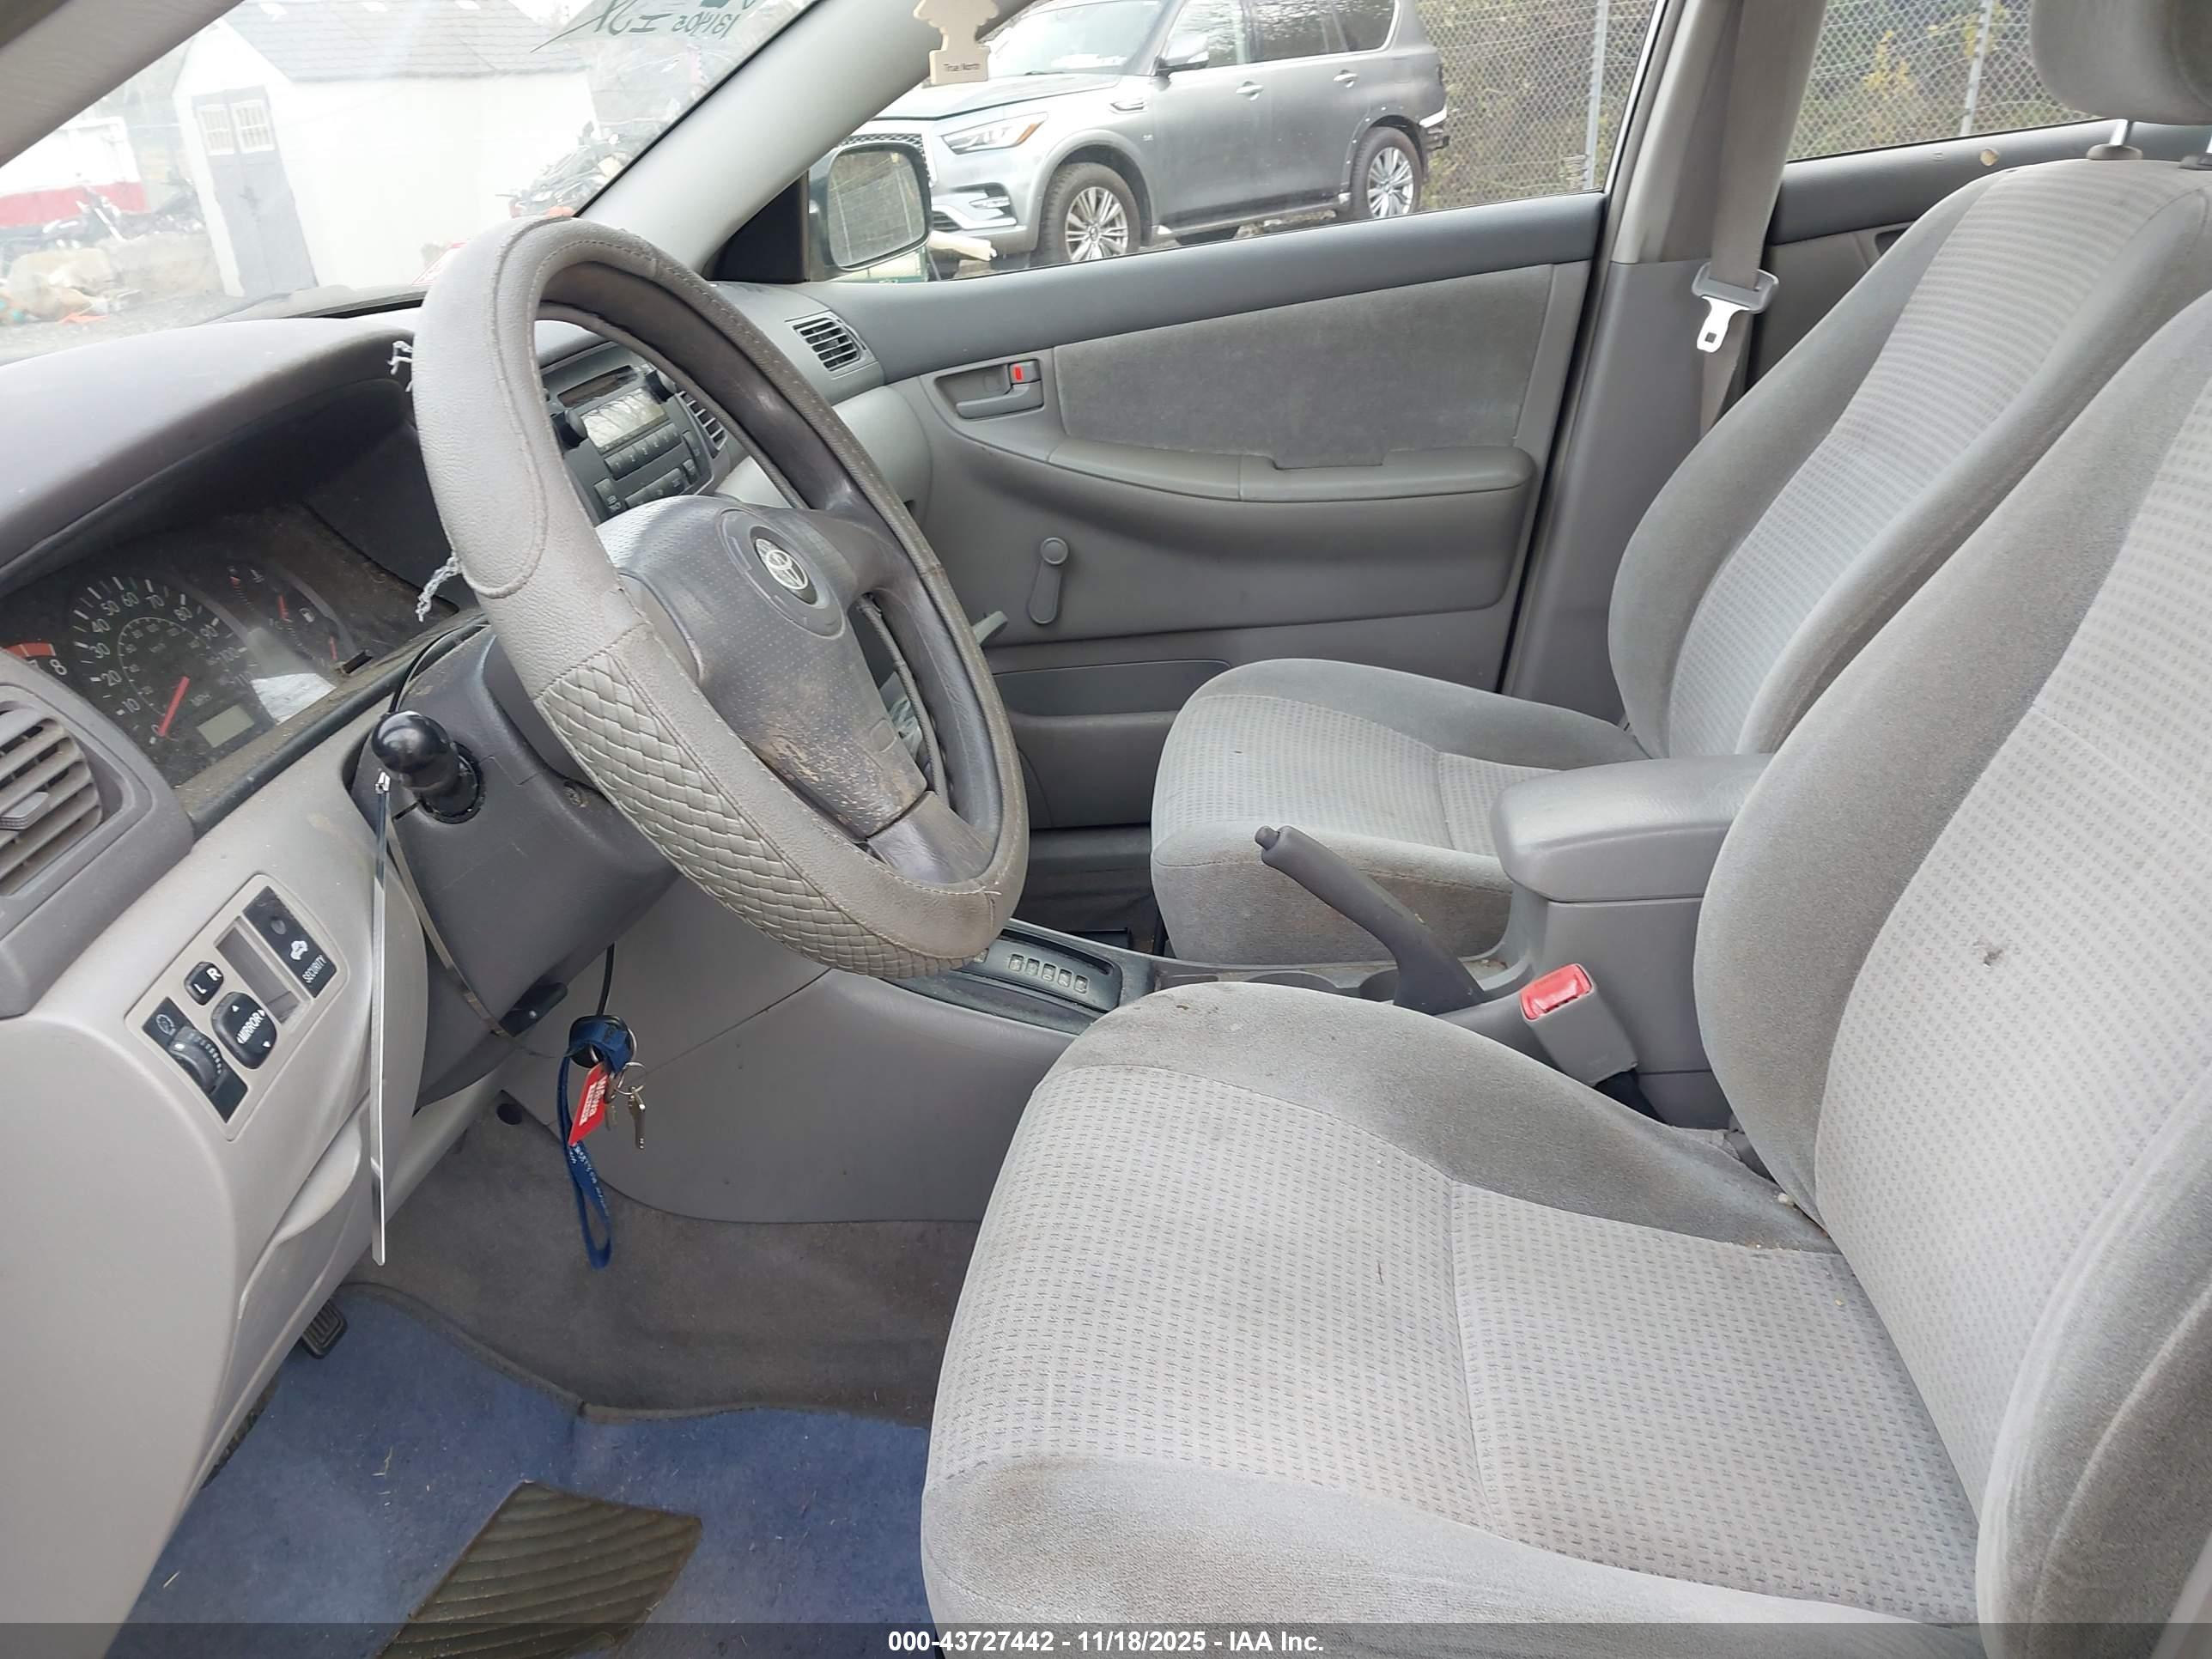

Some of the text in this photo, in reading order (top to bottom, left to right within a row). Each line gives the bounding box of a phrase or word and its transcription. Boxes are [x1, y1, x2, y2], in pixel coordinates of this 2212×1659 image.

[122, 592, 140, 607] 60
[145, 594, 165, 609] 70
[100, 600, 120, 616] 50
[173, 606, 192, 622] 80
[91, 618, 111, 633] 40
[199, 623, 218, 640] 90
[88, 642, 110, 659] 30
[49, 659, 67, 675] 8
[100, 670, 122, 687] 20
[121, 697, 141, 714] 10
[206, 967, 222, 981] R
[301, 955, 326, 983] SECURITY
[193, 982, 207, 994] L
[240, 1012, 262, 1043] MIRROR
